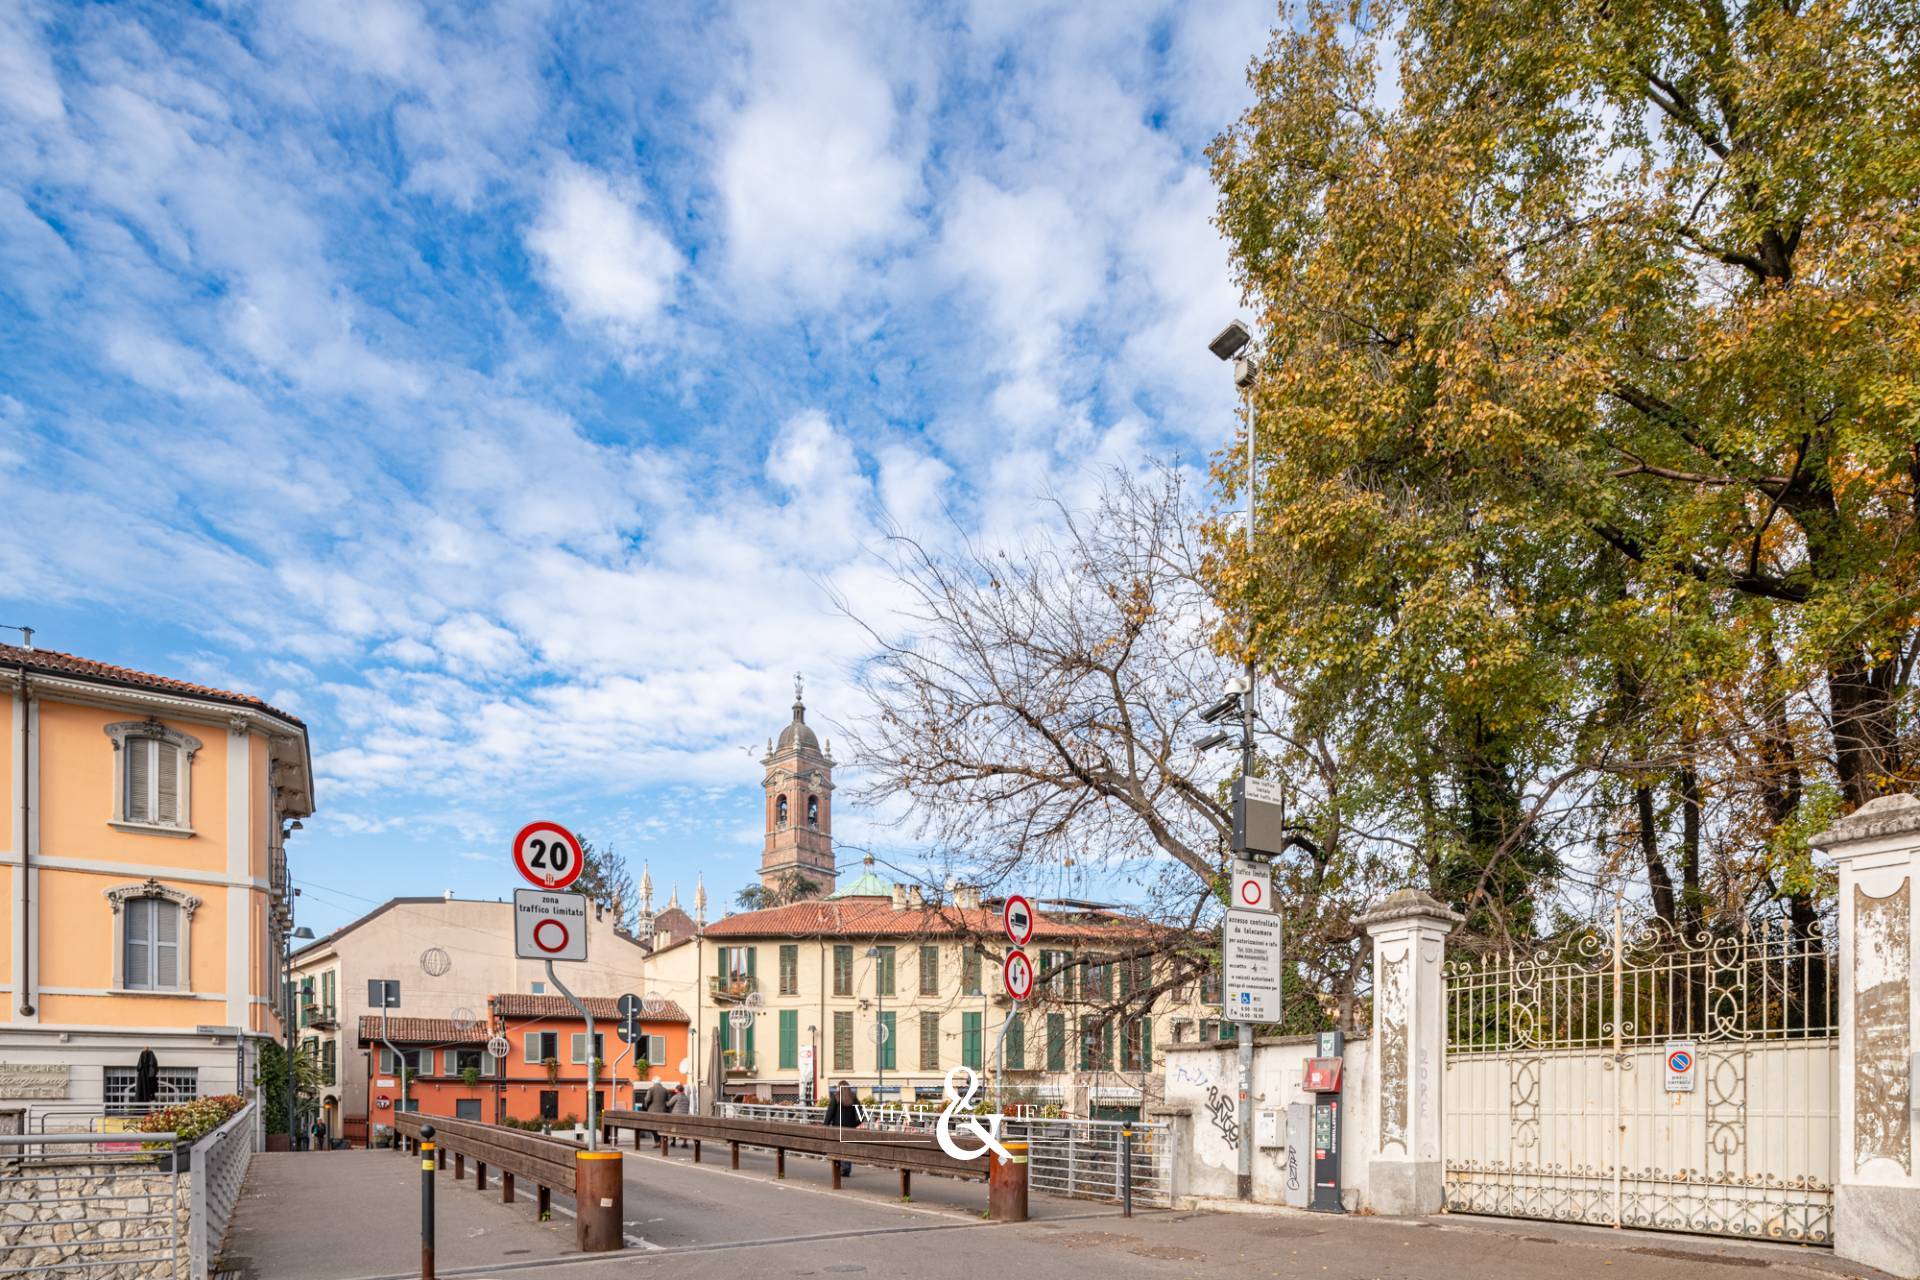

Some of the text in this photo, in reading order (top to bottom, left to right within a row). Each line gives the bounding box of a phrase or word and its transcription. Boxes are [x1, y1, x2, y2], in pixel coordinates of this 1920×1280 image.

[529, 839, 568, 872] 20
[542, 896, 559, 904] zona
[519, 904, 584, 917] traffico limitato
[1229, 917, 1278, 928] accesso controllato
